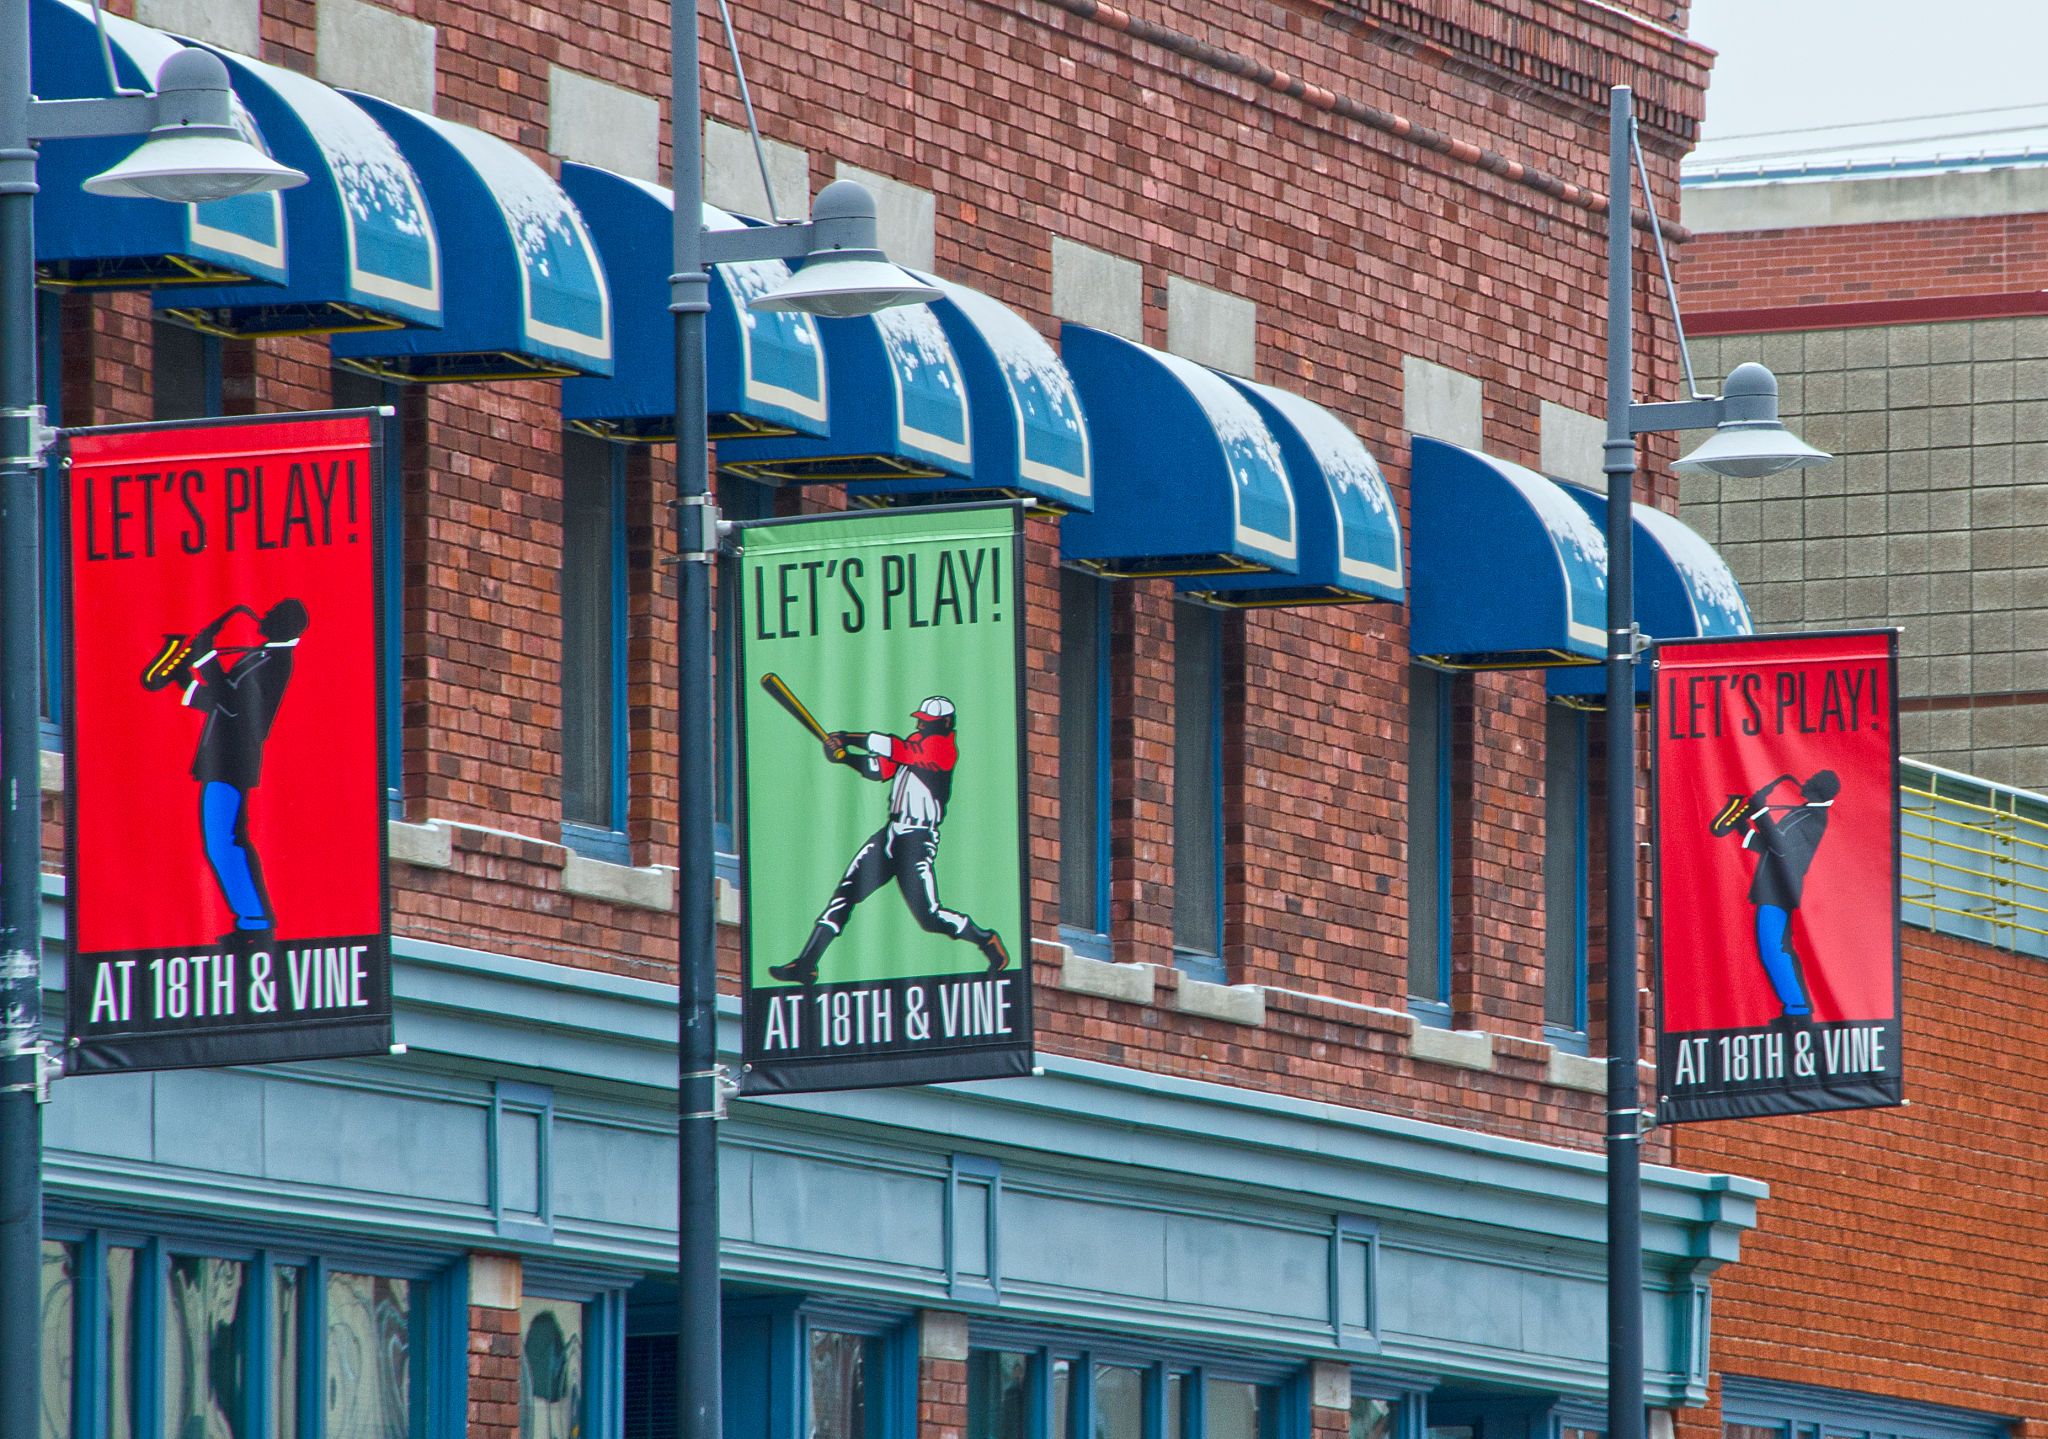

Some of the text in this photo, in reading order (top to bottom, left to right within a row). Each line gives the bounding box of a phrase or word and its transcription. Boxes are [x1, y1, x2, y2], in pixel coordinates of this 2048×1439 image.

[84, 460, 359, 562] LET'S PLAY!
[755, 547, 1001, 640] LET'S PLAY!
[1669, 668, 1879, 740] LET'S PLAY!
[90, 946, 368, 1023] AT 18TH & VINE
[764, 980, 1011, 1051] AT 18TH & VINE
[1675, 1027, 1885, 1085] AT 18TH & VINE
